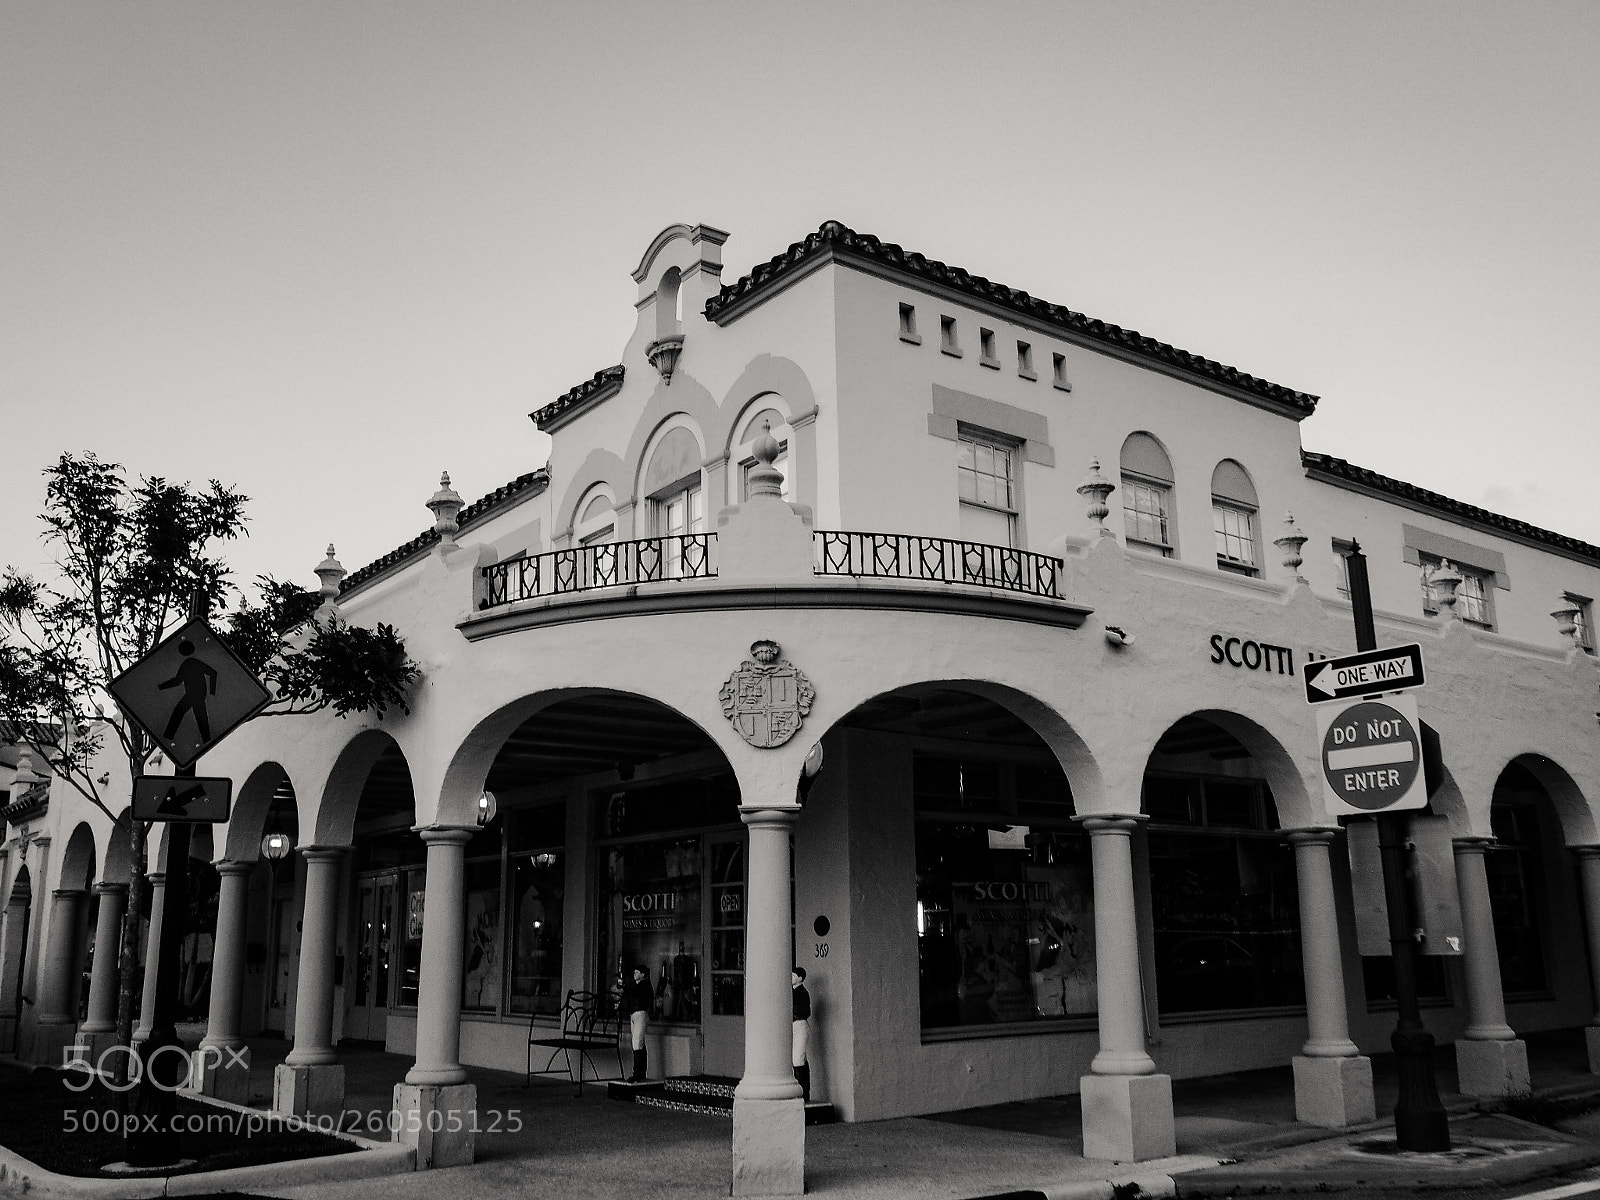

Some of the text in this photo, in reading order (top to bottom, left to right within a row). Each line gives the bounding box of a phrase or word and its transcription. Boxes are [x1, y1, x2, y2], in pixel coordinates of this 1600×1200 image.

[1210, 634, 1295, 676] SCOTTI
[1337, 659, 1408, 686] ONE WAY
[1333, 719, 1402, 744] DO NOT
[1344, 769, 1401, 792] ENTER
[975, 882, 1050, 901] SCOTTI
[624, 893, 675, 912] SCOTTI
[721, 895, 740, 911] OPEN
[815, 943, 830, 958] 369
